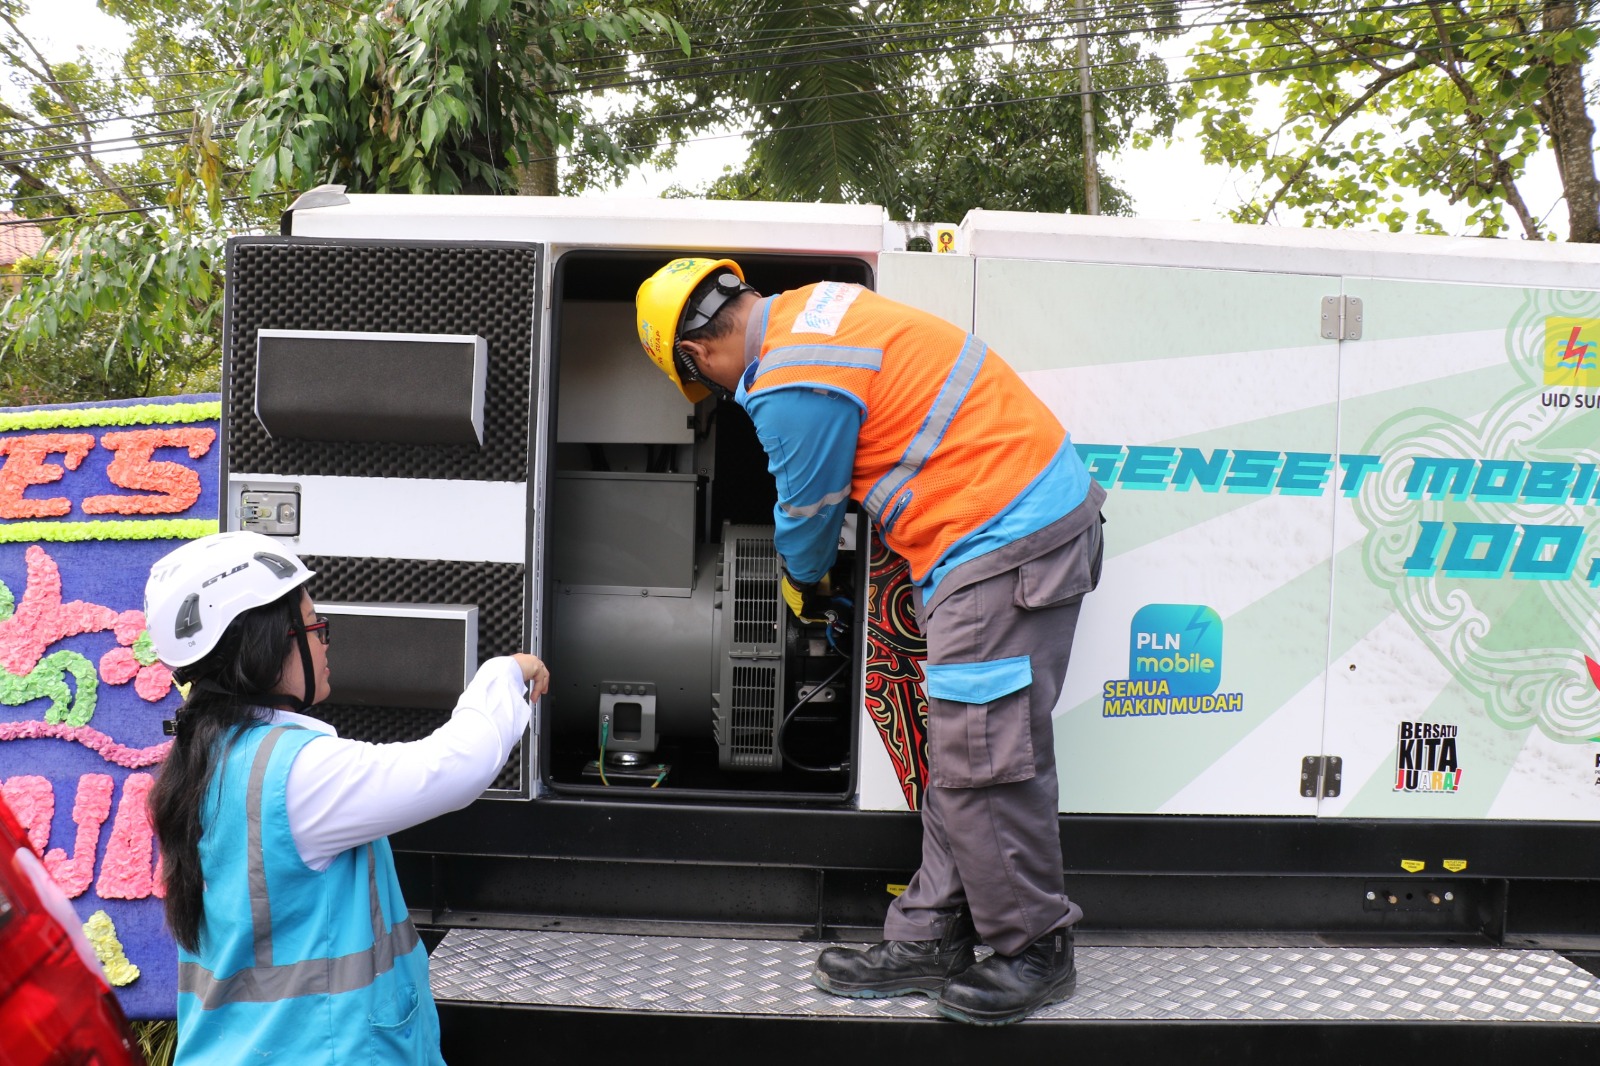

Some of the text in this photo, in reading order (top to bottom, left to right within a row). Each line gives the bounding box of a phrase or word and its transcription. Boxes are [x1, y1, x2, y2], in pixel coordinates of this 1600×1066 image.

[1542, 393, 1570, 407] UID
[1073, 443, 1600, 507] GENSET MOBI
[1136, 632, 1181, 650] PLN
[1136, 652, 1215, 674] mobile
[1104, 679, 1170, 698] SEMUA
[1104, 694, 1243, 717] MAKIN MUDAH
[1400, 721, 1458, 739] BERSATU
[1399, 738, 1458, 772] KITA
[1395, 768, 1463, 791] JUARA!
